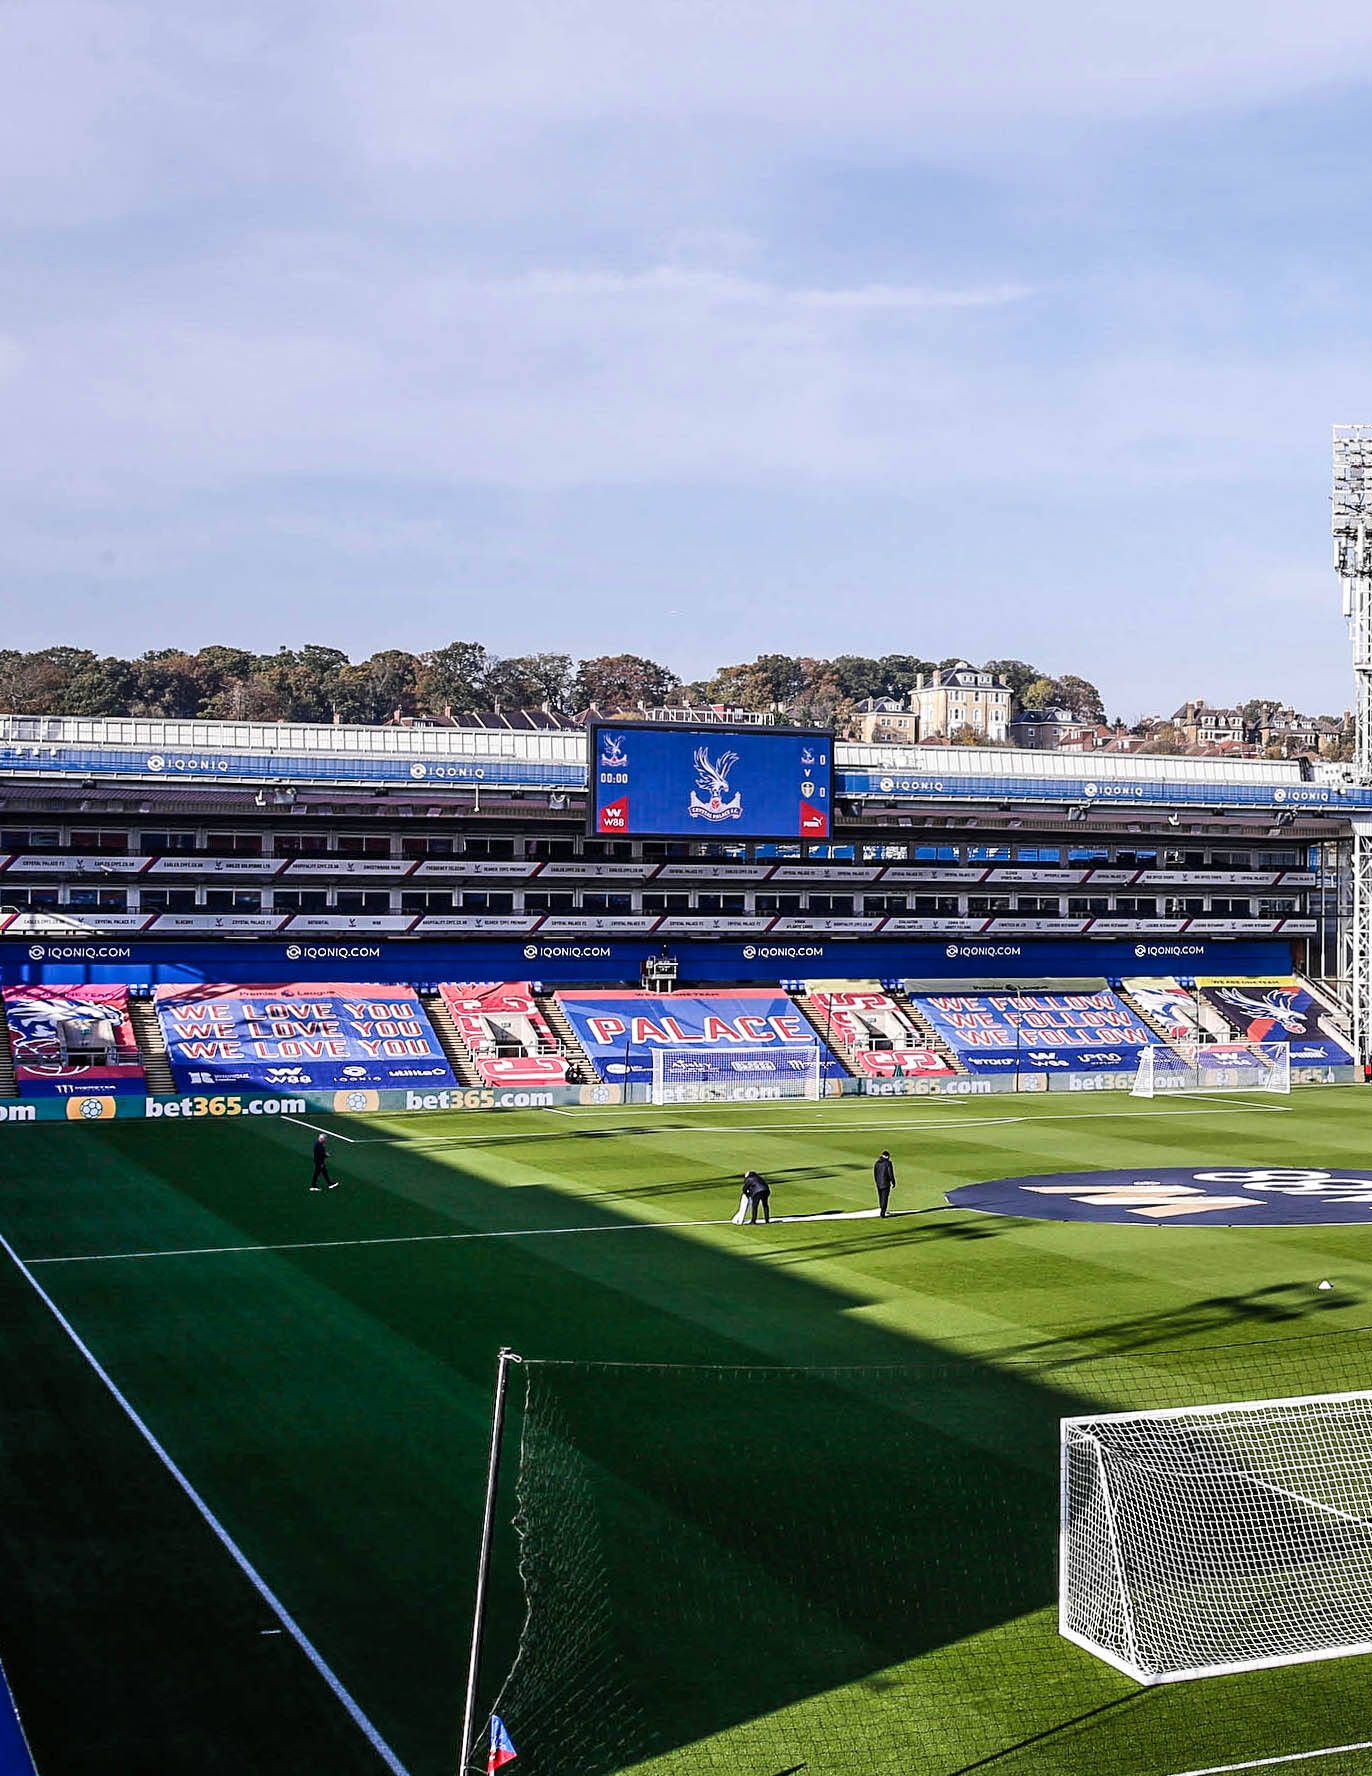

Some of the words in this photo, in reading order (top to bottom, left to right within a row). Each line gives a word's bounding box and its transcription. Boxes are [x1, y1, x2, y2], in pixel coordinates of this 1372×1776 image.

[167, 759, 229, 773] IQONIQ
[429, 767, 485, 780] IQONIQ
[600, 773, 628, 784] 00:00
[896, 779, 944, 792] IQONIQ
[1099, 785, 1144, 798] IQONIQ
[1288, 790, 1329, 803] IQONIQ
[604, 817, 625, 827] W88
[48, 946, 131, 960] IQONIQ.COM
[303, 946, 380, 959] IQONIQ.COM
[540, 946, 611, 959] IQONIQ.COM
[758, 946, 823, 959] IQONIQ.COM
[960, 945, 1021, 959] IQONIQ.COM
[1147, 944, 1204, 957] IQONIQ.COM
[928, 996, 988, 1013] WE
[990, 995, 1115, 1013] FOLLOW
[170, 1003, 233, 1022] WE
[243, 1003, 338, 1021] LOVE
[344, 1002, 415, 1020] YOU
[941, 1012, 1004, 1030] WE
[1004, 1010, 1133, 1030] FOLLOW
[176, 1022, 240, 1040] WE
[250, 1021, 346, 1040] LOVE
[351, 1021, 424, 1038] YOU
[586, 1015, 815, 1045] PALACE
[955, 1029, 1018, 1048] WE
[1019, 1027, 1149, 1048] FOLLOW
[182, 1040, 246, 1060] WE
[256, 1039, 351, 1060] LOVE
[358, 1038, 431, 1057] YOU
[264, 1075, 312, 1084] W88
[866, 1079, 991, 1097] bet365.com
[145, 1096, 306, 1118] bet365.com
[406, 1089, 554, 1111] bet365.com
